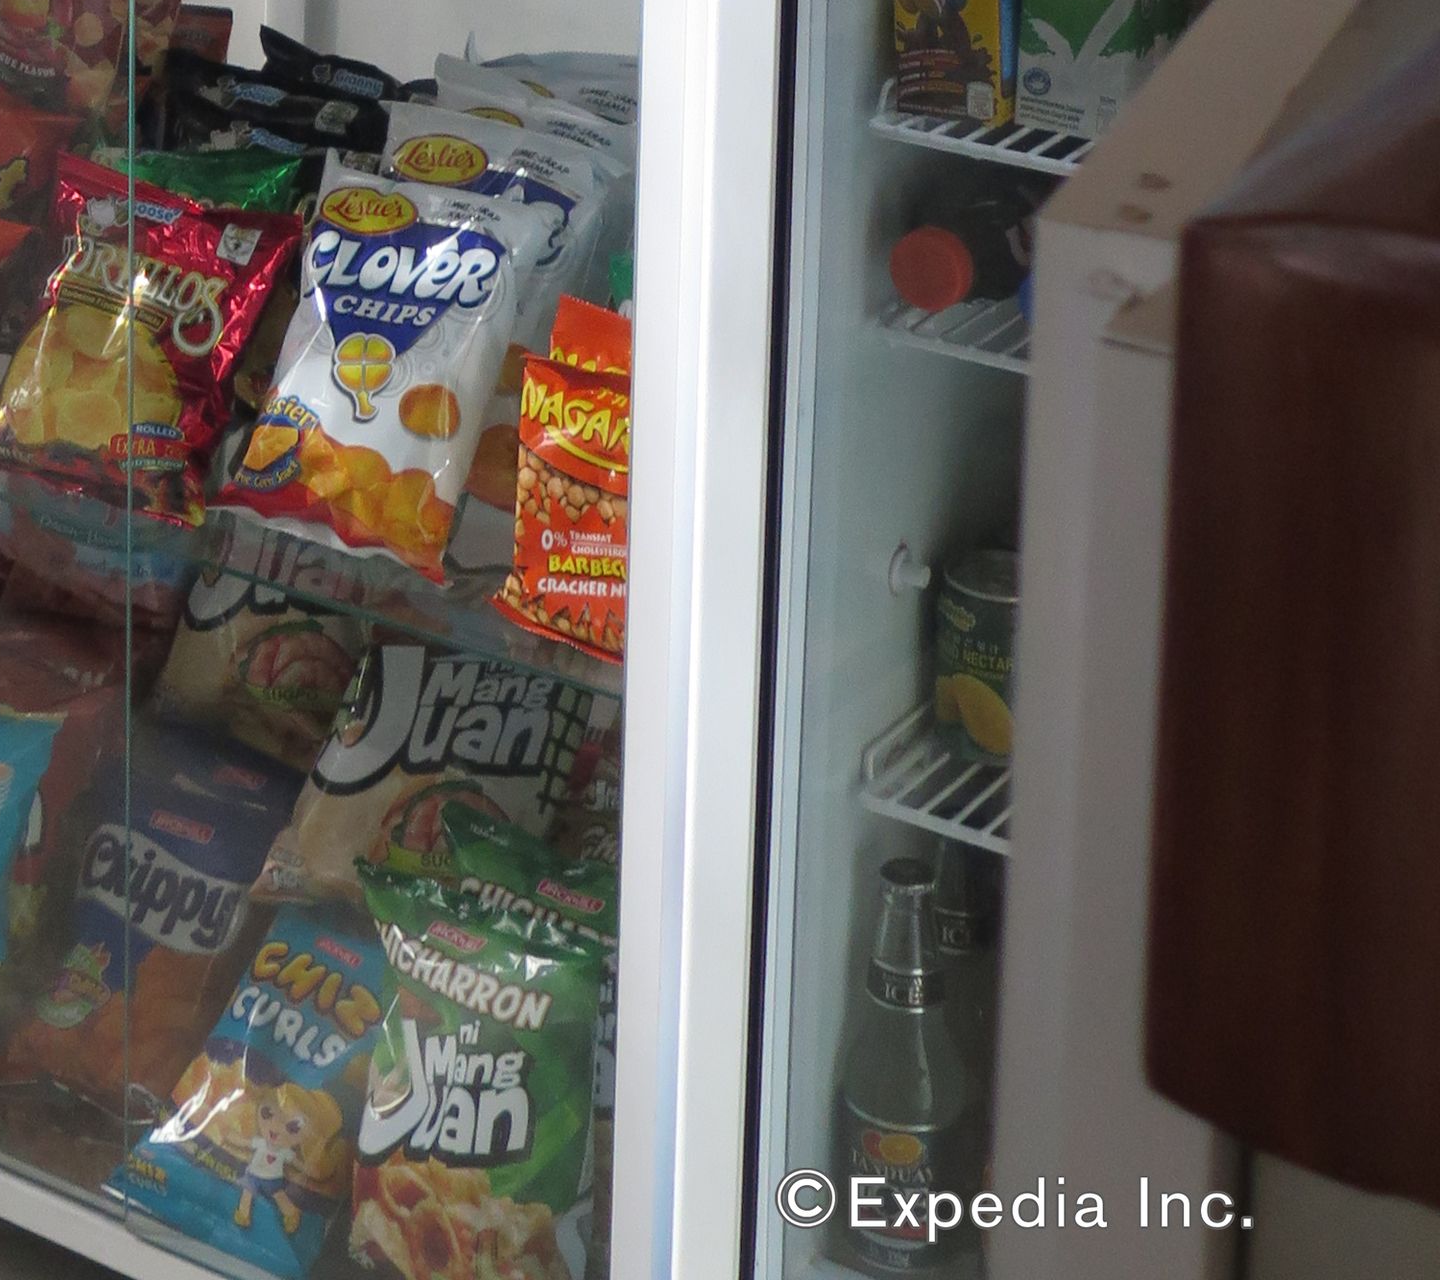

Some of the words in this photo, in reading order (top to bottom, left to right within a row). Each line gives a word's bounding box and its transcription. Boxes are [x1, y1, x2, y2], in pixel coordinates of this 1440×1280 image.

[332, 295, 437, 334] CHIPS
[136, 423, 177, 438] ROLLED
[537, 577, 608, 597] CRACKER
[311, 645, 548, 797] Juan
[79, 832, 247, 946] Chippy
[231, 985, 349, 1069] CURLS
[252, 940, 384, 1039] CHIZ
[357, 1018, 533, 1161] Juan
[426, 1034, 527, 1088] Mang
